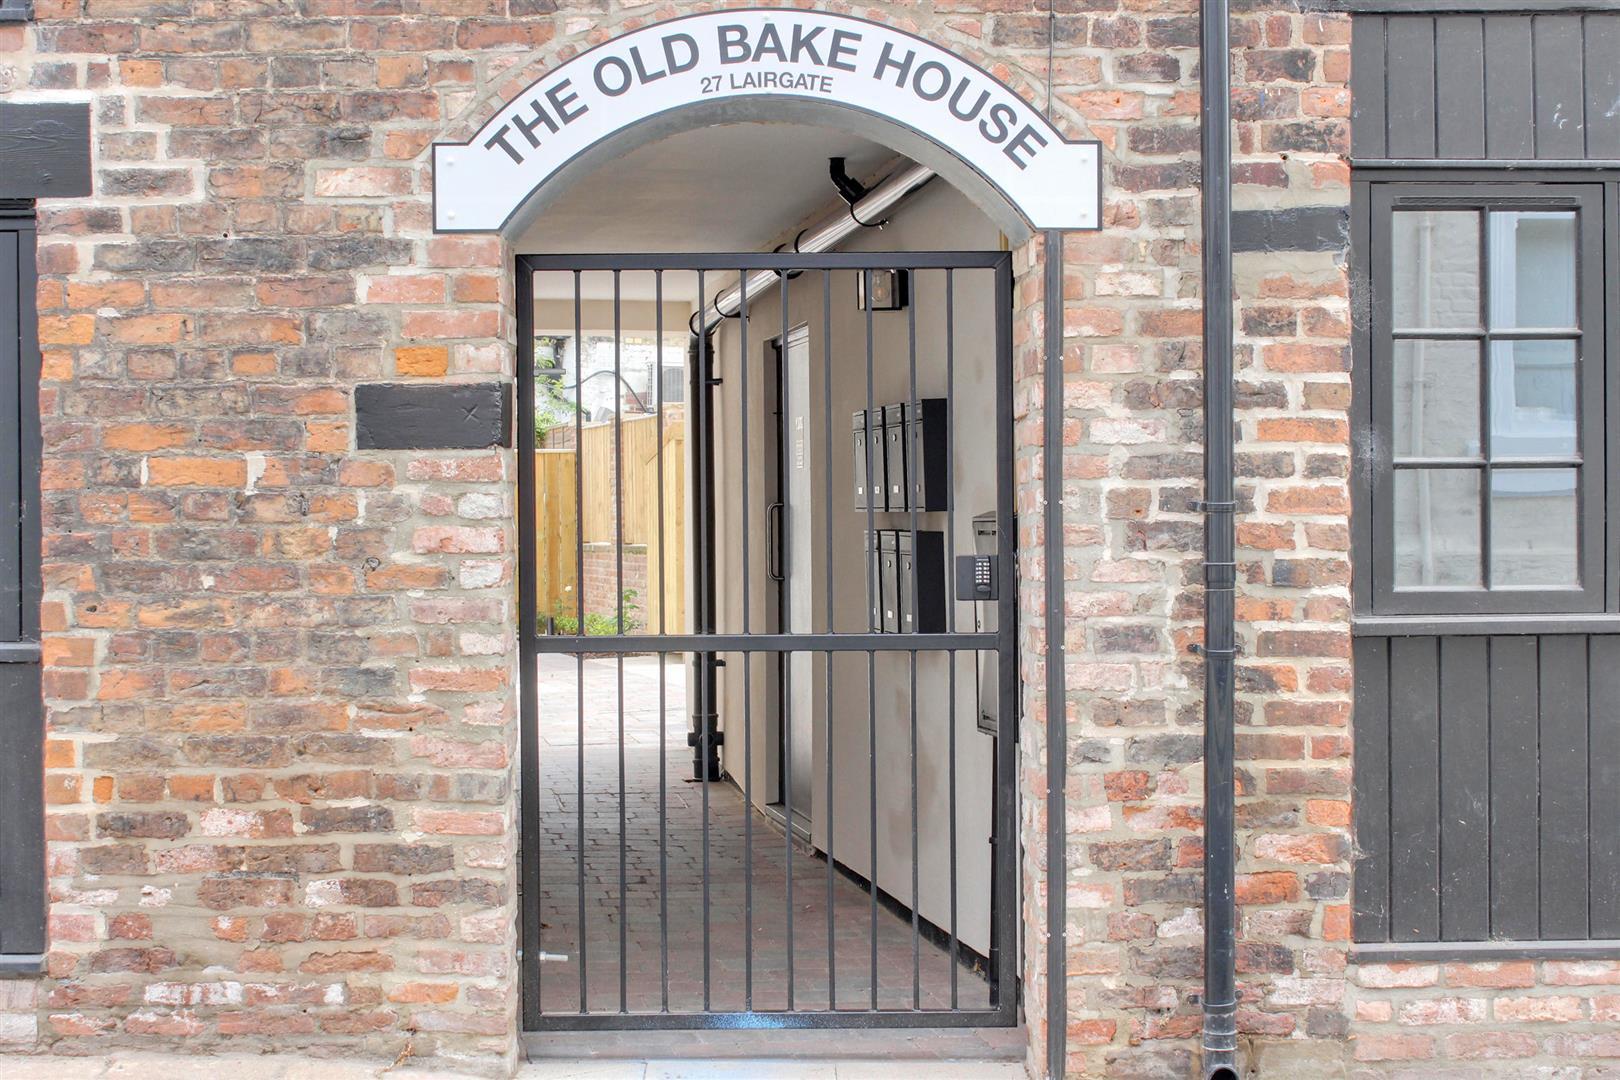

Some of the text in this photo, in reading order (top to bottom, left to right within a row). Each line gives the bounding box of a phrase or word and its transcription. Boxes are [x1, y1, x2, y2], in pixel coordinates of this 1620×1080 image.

[484, 23, 1049, 171] THE OLD BAKE HOUSE
[700, 72, 834, 94] 27 LAIRGATE
